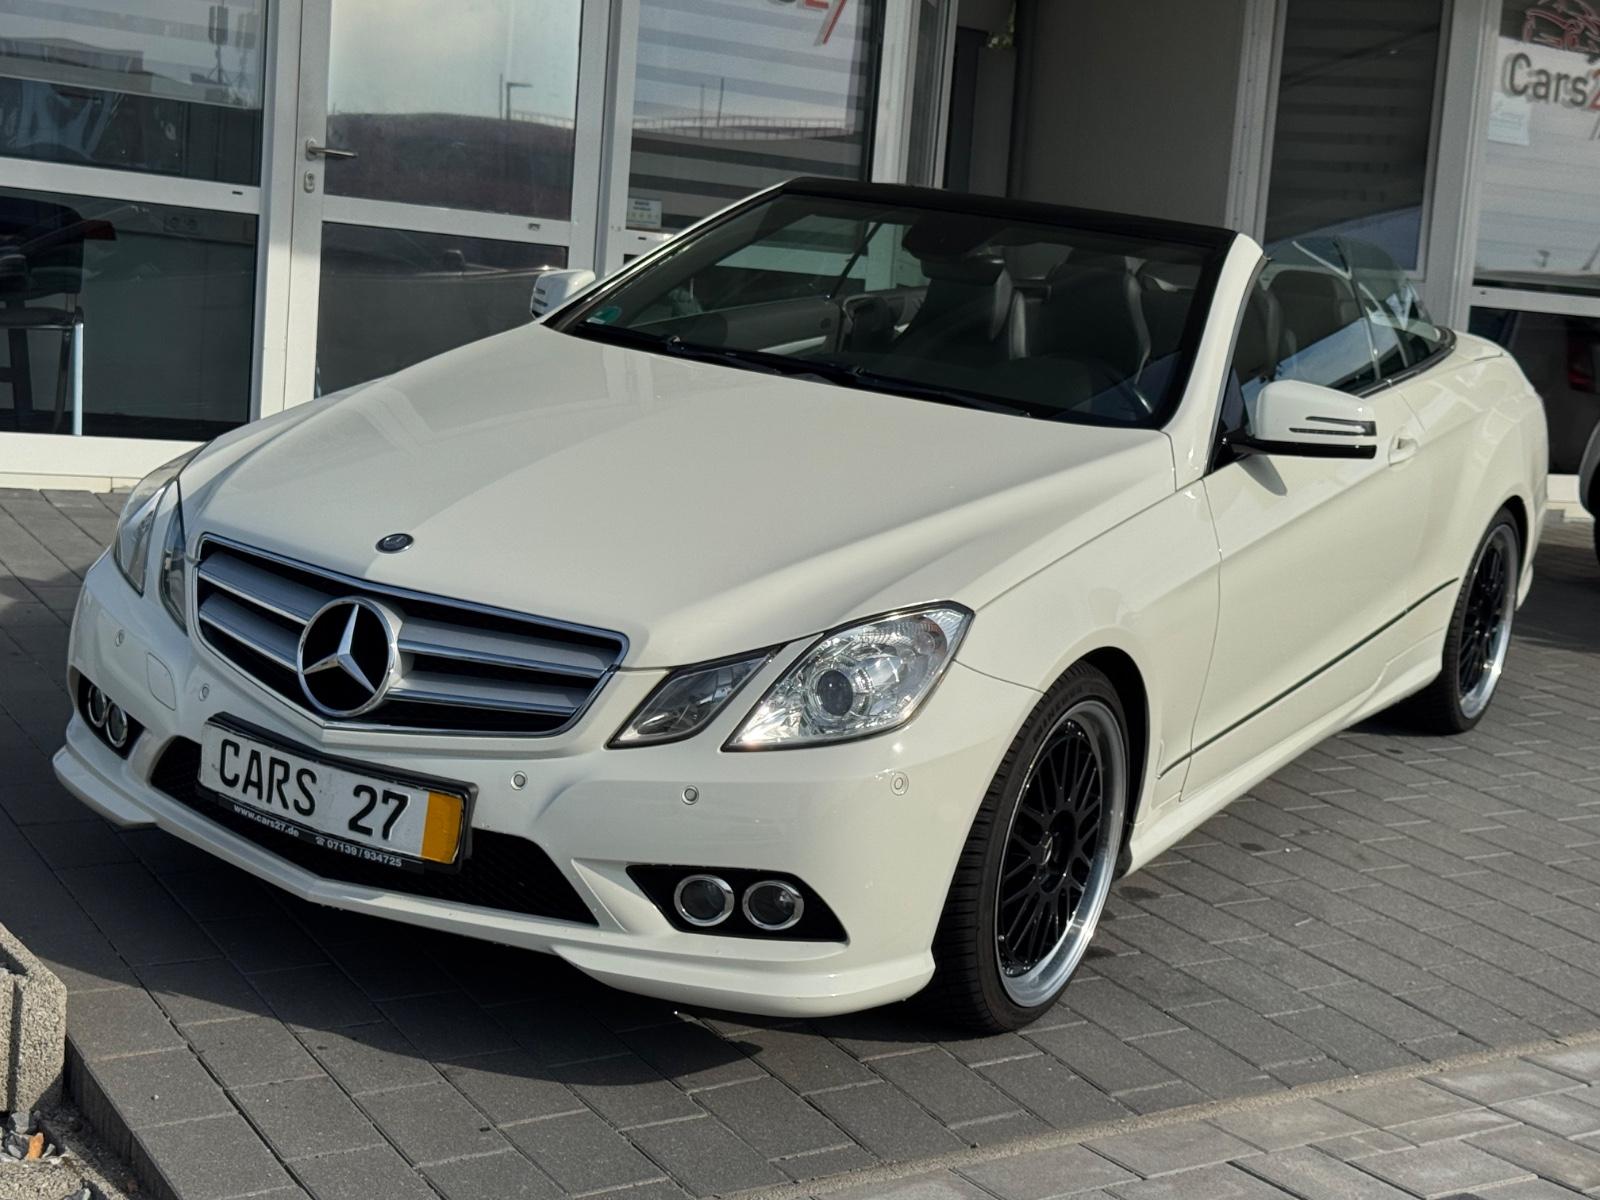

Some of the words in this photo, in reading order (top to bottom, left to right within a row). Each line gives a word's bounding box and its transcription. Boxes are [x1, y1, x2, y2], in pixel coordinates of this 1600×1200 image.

[219, 738, 317, 817] CARS
[348, 784, 411, 841] 27
[234, 804, 300, 837] www.cars27.de
